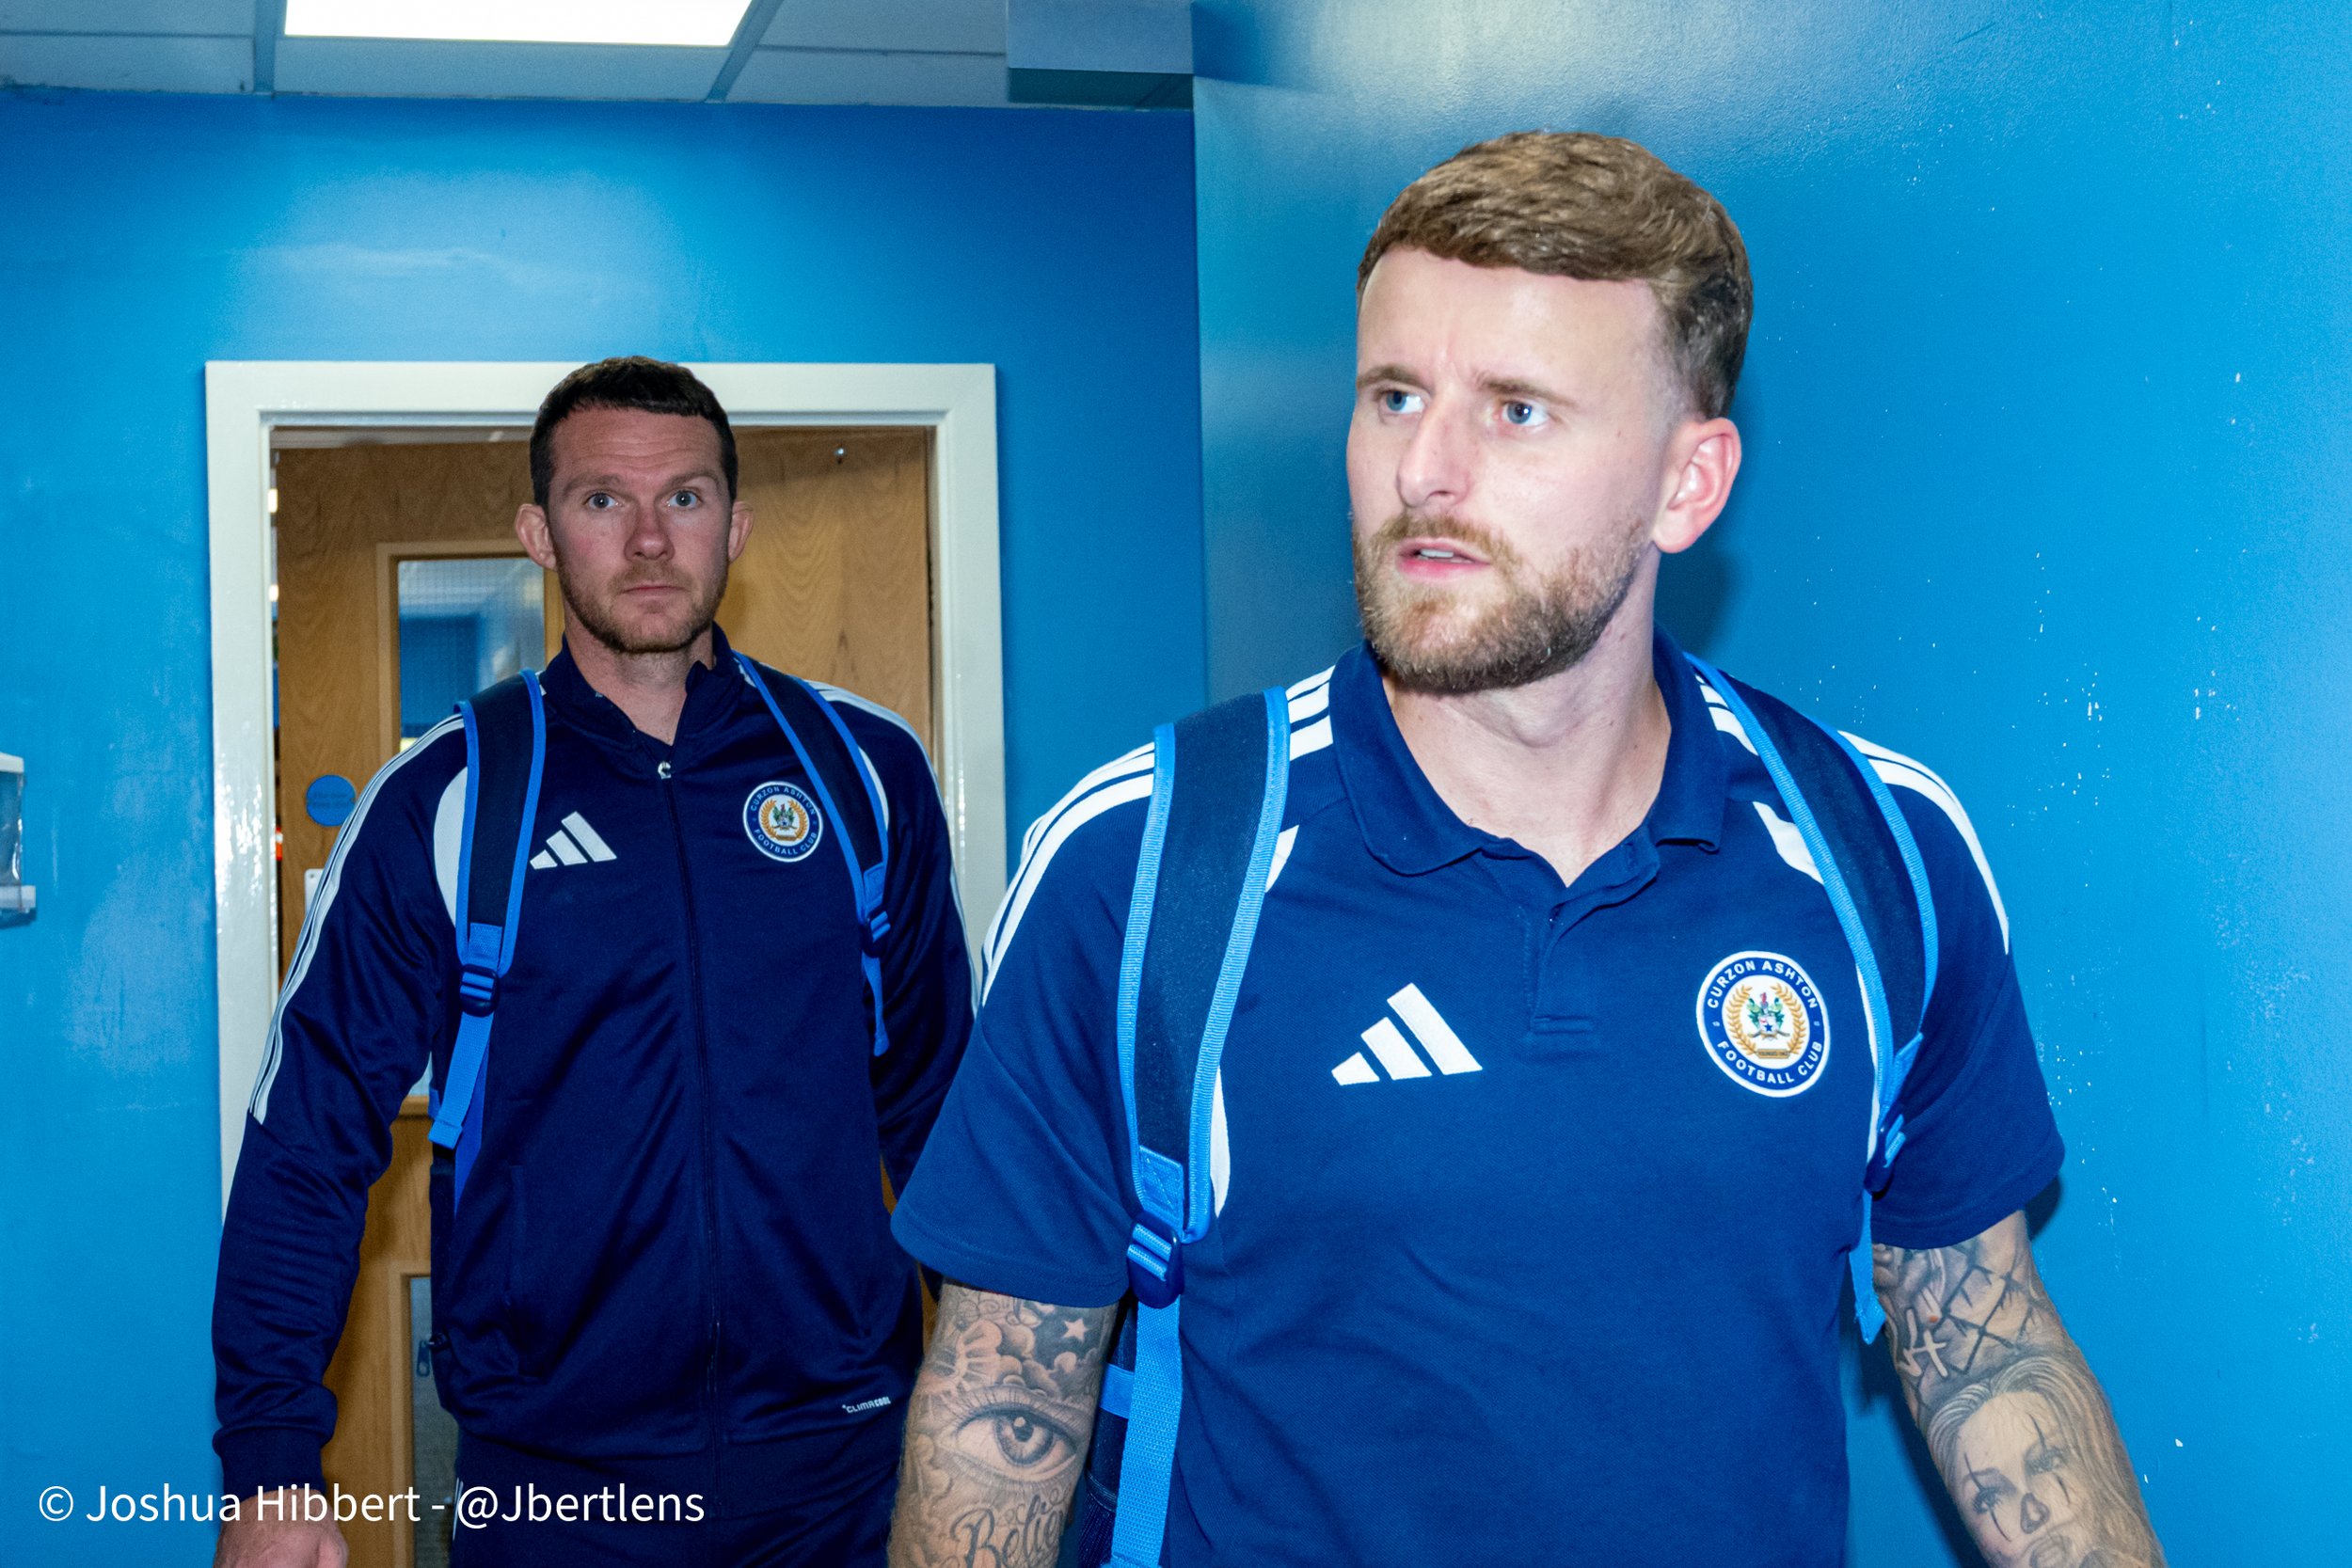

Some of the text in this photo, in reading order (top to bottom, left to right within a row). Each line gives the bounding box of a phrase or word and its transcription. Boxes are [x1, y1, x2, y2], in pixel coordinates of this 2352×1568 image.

[750, 785, 817, 816] CURZON ASHTON
[754, 828, 818, 855] FOOTBALL CLUB
[1707, 959, 1819, 1009] CURZON ASHTON
[1716, 1039, 1823, 1085] FOOTBALL CLUB
